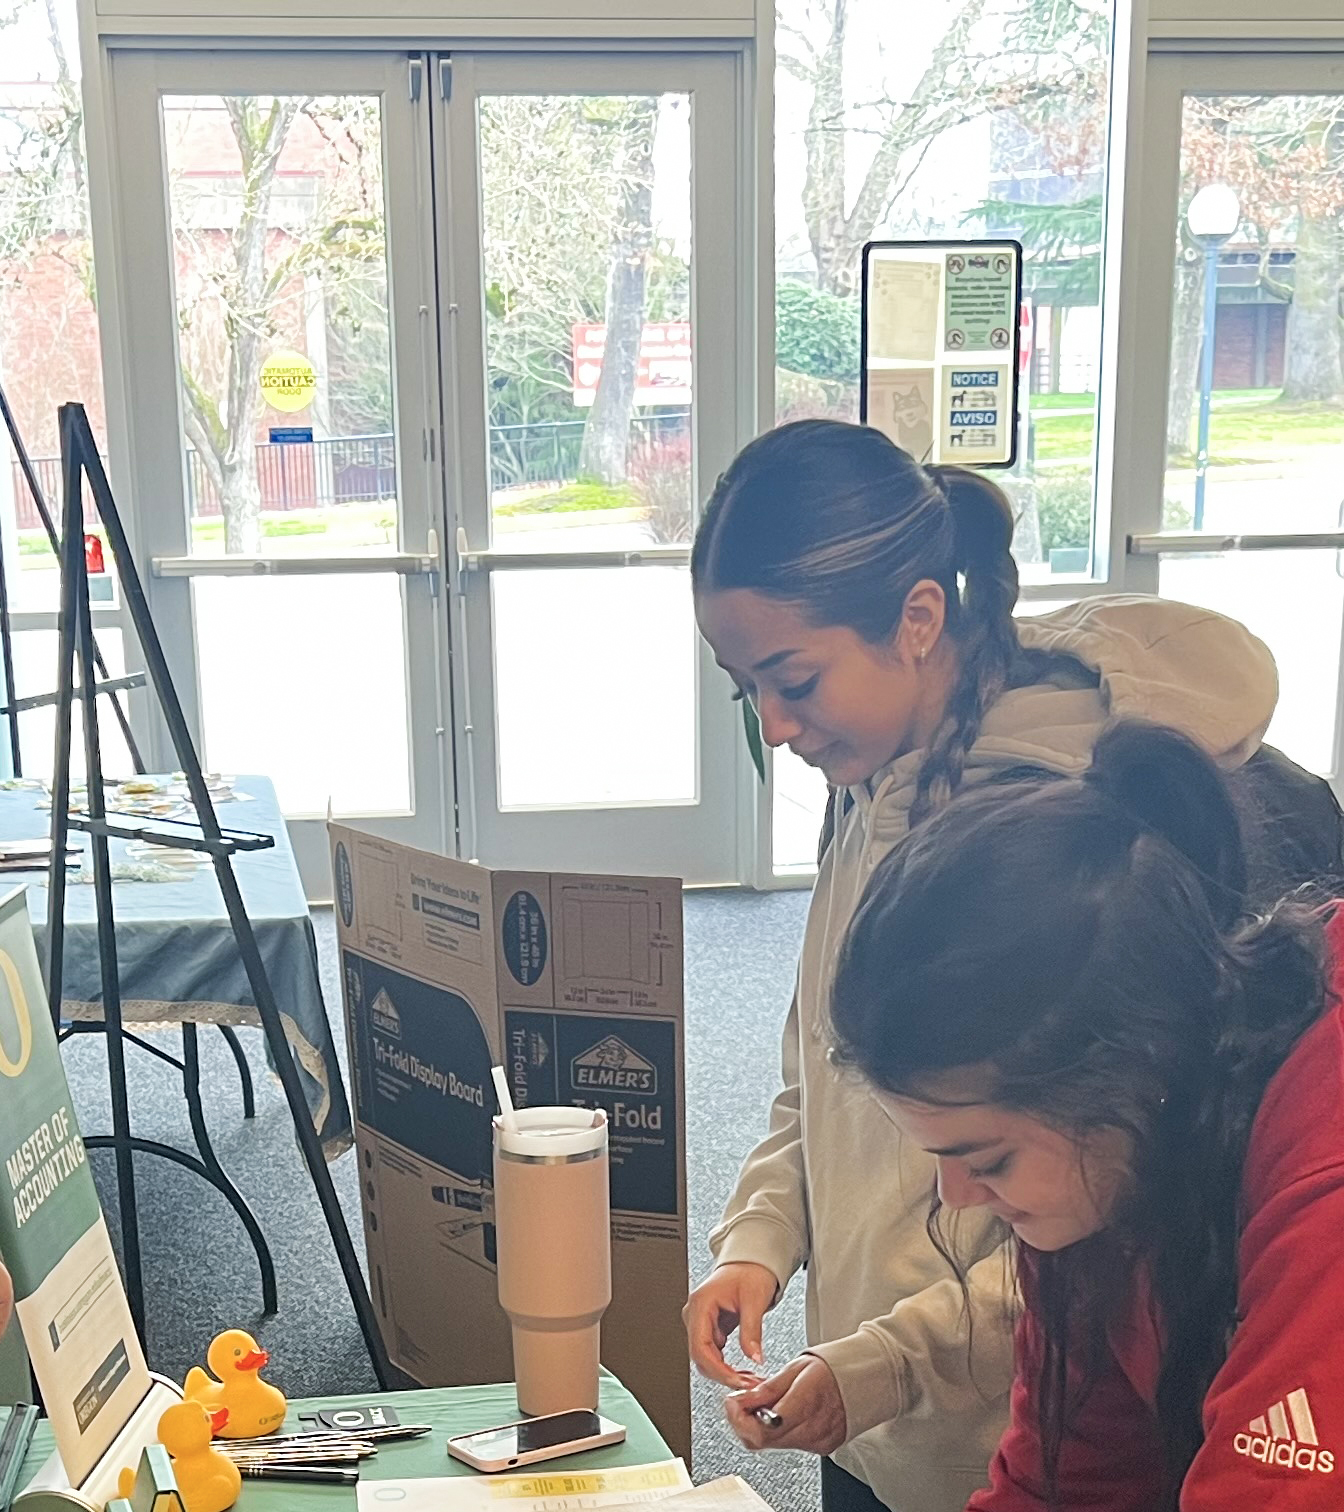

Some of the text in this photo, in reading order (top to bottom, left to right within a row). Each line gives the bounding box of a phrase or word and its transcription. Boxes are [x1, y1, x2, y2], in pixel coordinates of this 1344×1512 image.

[953, 373, 997, 385] NOTICE
[952, 413, 995, 424] AVISO
[373, 1014, 399, 1034] ELMER'S
[373, 1038, 409, 1075] Tri-Fold
[410, 1056, 448, 1096] Display
[449, 1072, 484, 1108] Board
[512, 1029, 527, 1085] Tri-Fold
[577, 1068, 652, 1089] ELMER'S
[5, 1107, 70, 1189] MASTER OF
[13, 1134, 86, 1229] ACCOUNTING
[1233, 1432, 1336, 1474] adidas
